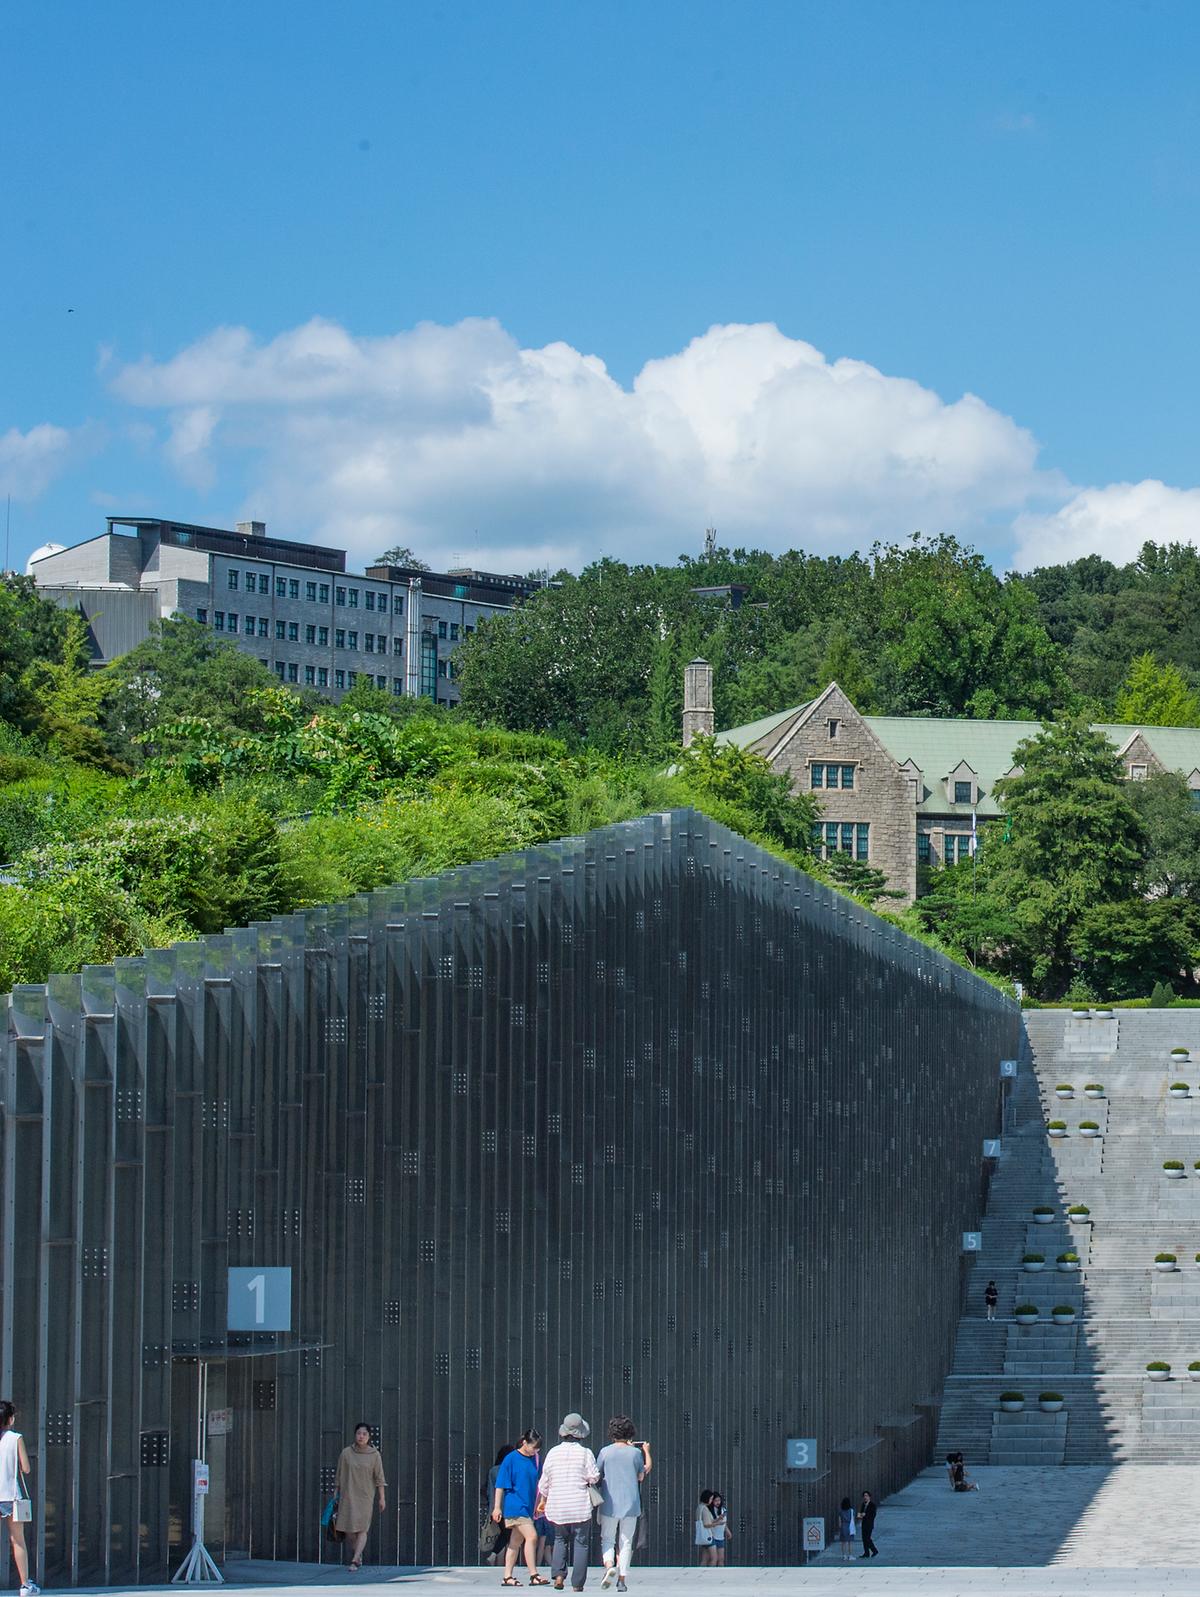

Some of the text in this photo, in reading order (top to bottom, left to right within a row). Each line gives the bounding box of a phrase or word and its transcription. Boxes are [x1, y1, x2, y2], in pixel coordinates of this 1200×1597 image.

[1005, 1062, 1012, 1075] 9
[988, 1141, 996, 1155] 7
[968, 1234, 976, 1248] 5
[247, 1274, 265, 1324] 1
[795, 1442, 809, 1466] 3
